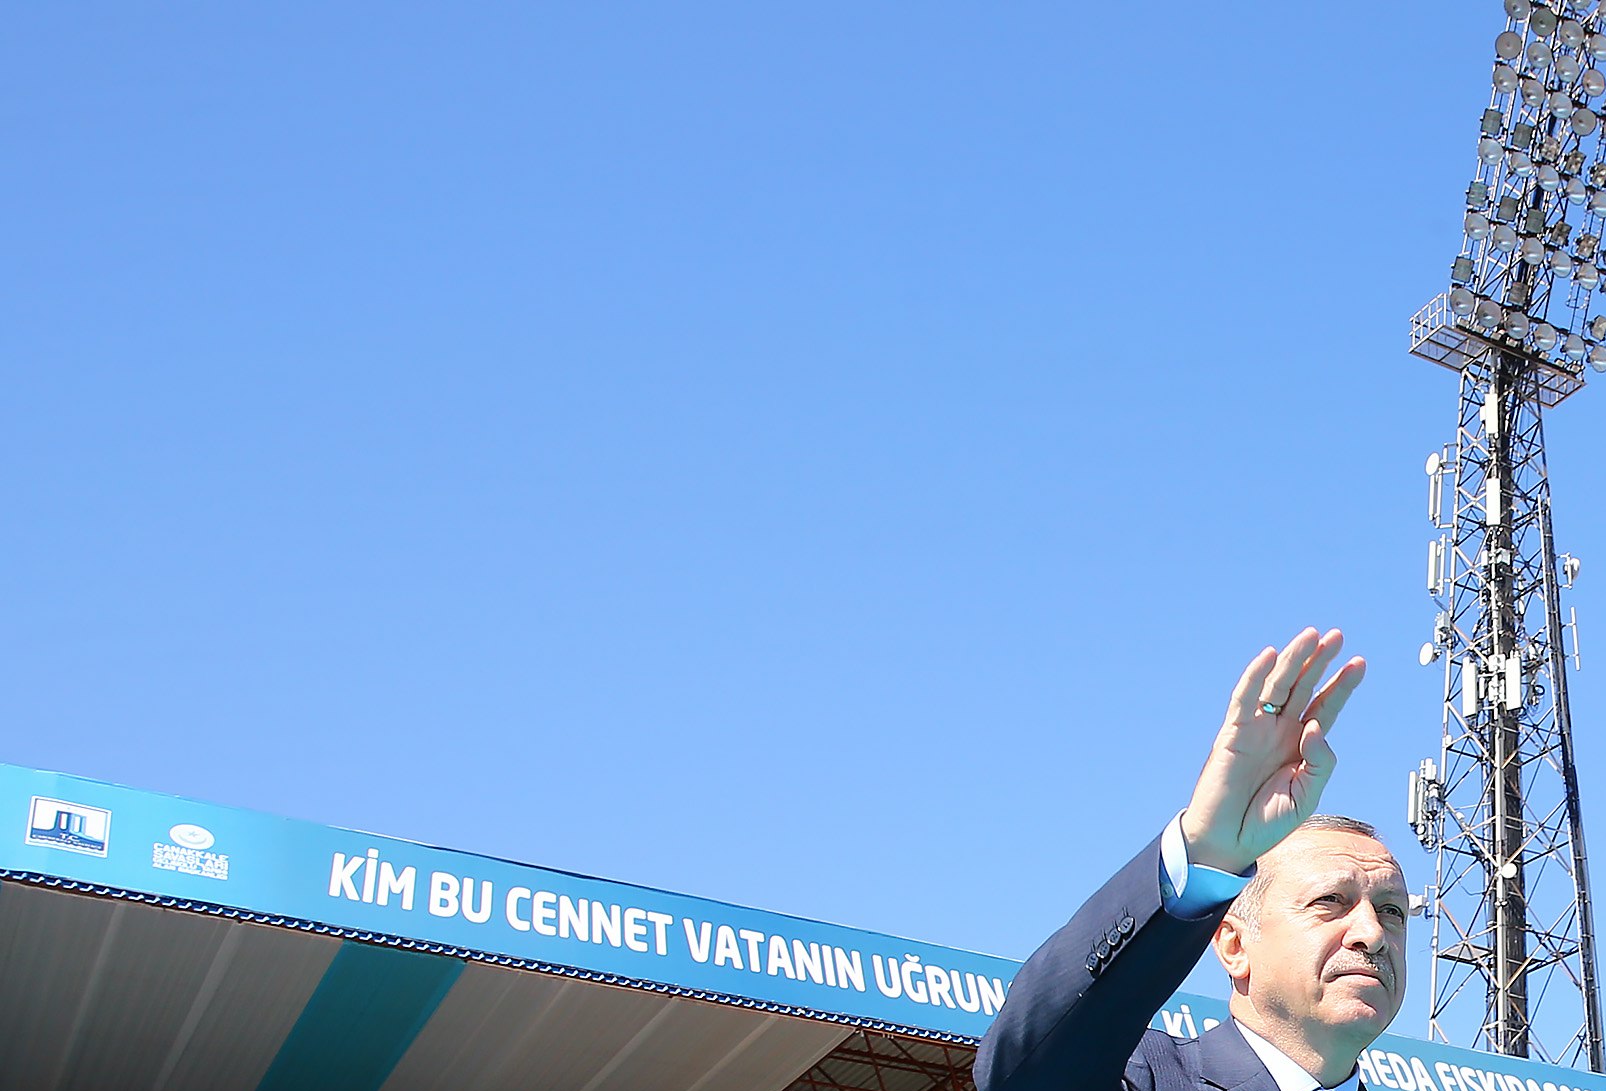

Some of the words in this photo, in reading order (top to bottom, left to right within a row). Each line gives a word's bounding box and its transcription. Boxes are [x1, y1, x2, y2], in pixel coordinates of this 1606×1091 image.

[328, 848, 417, 911] KİM
[428, 871, 493, 924] BU
[505, 886, 673, 956] CENNET
[682, 917, 866, 992] VATANIN
[872, 953, 1012, 1016] UĞRUN
